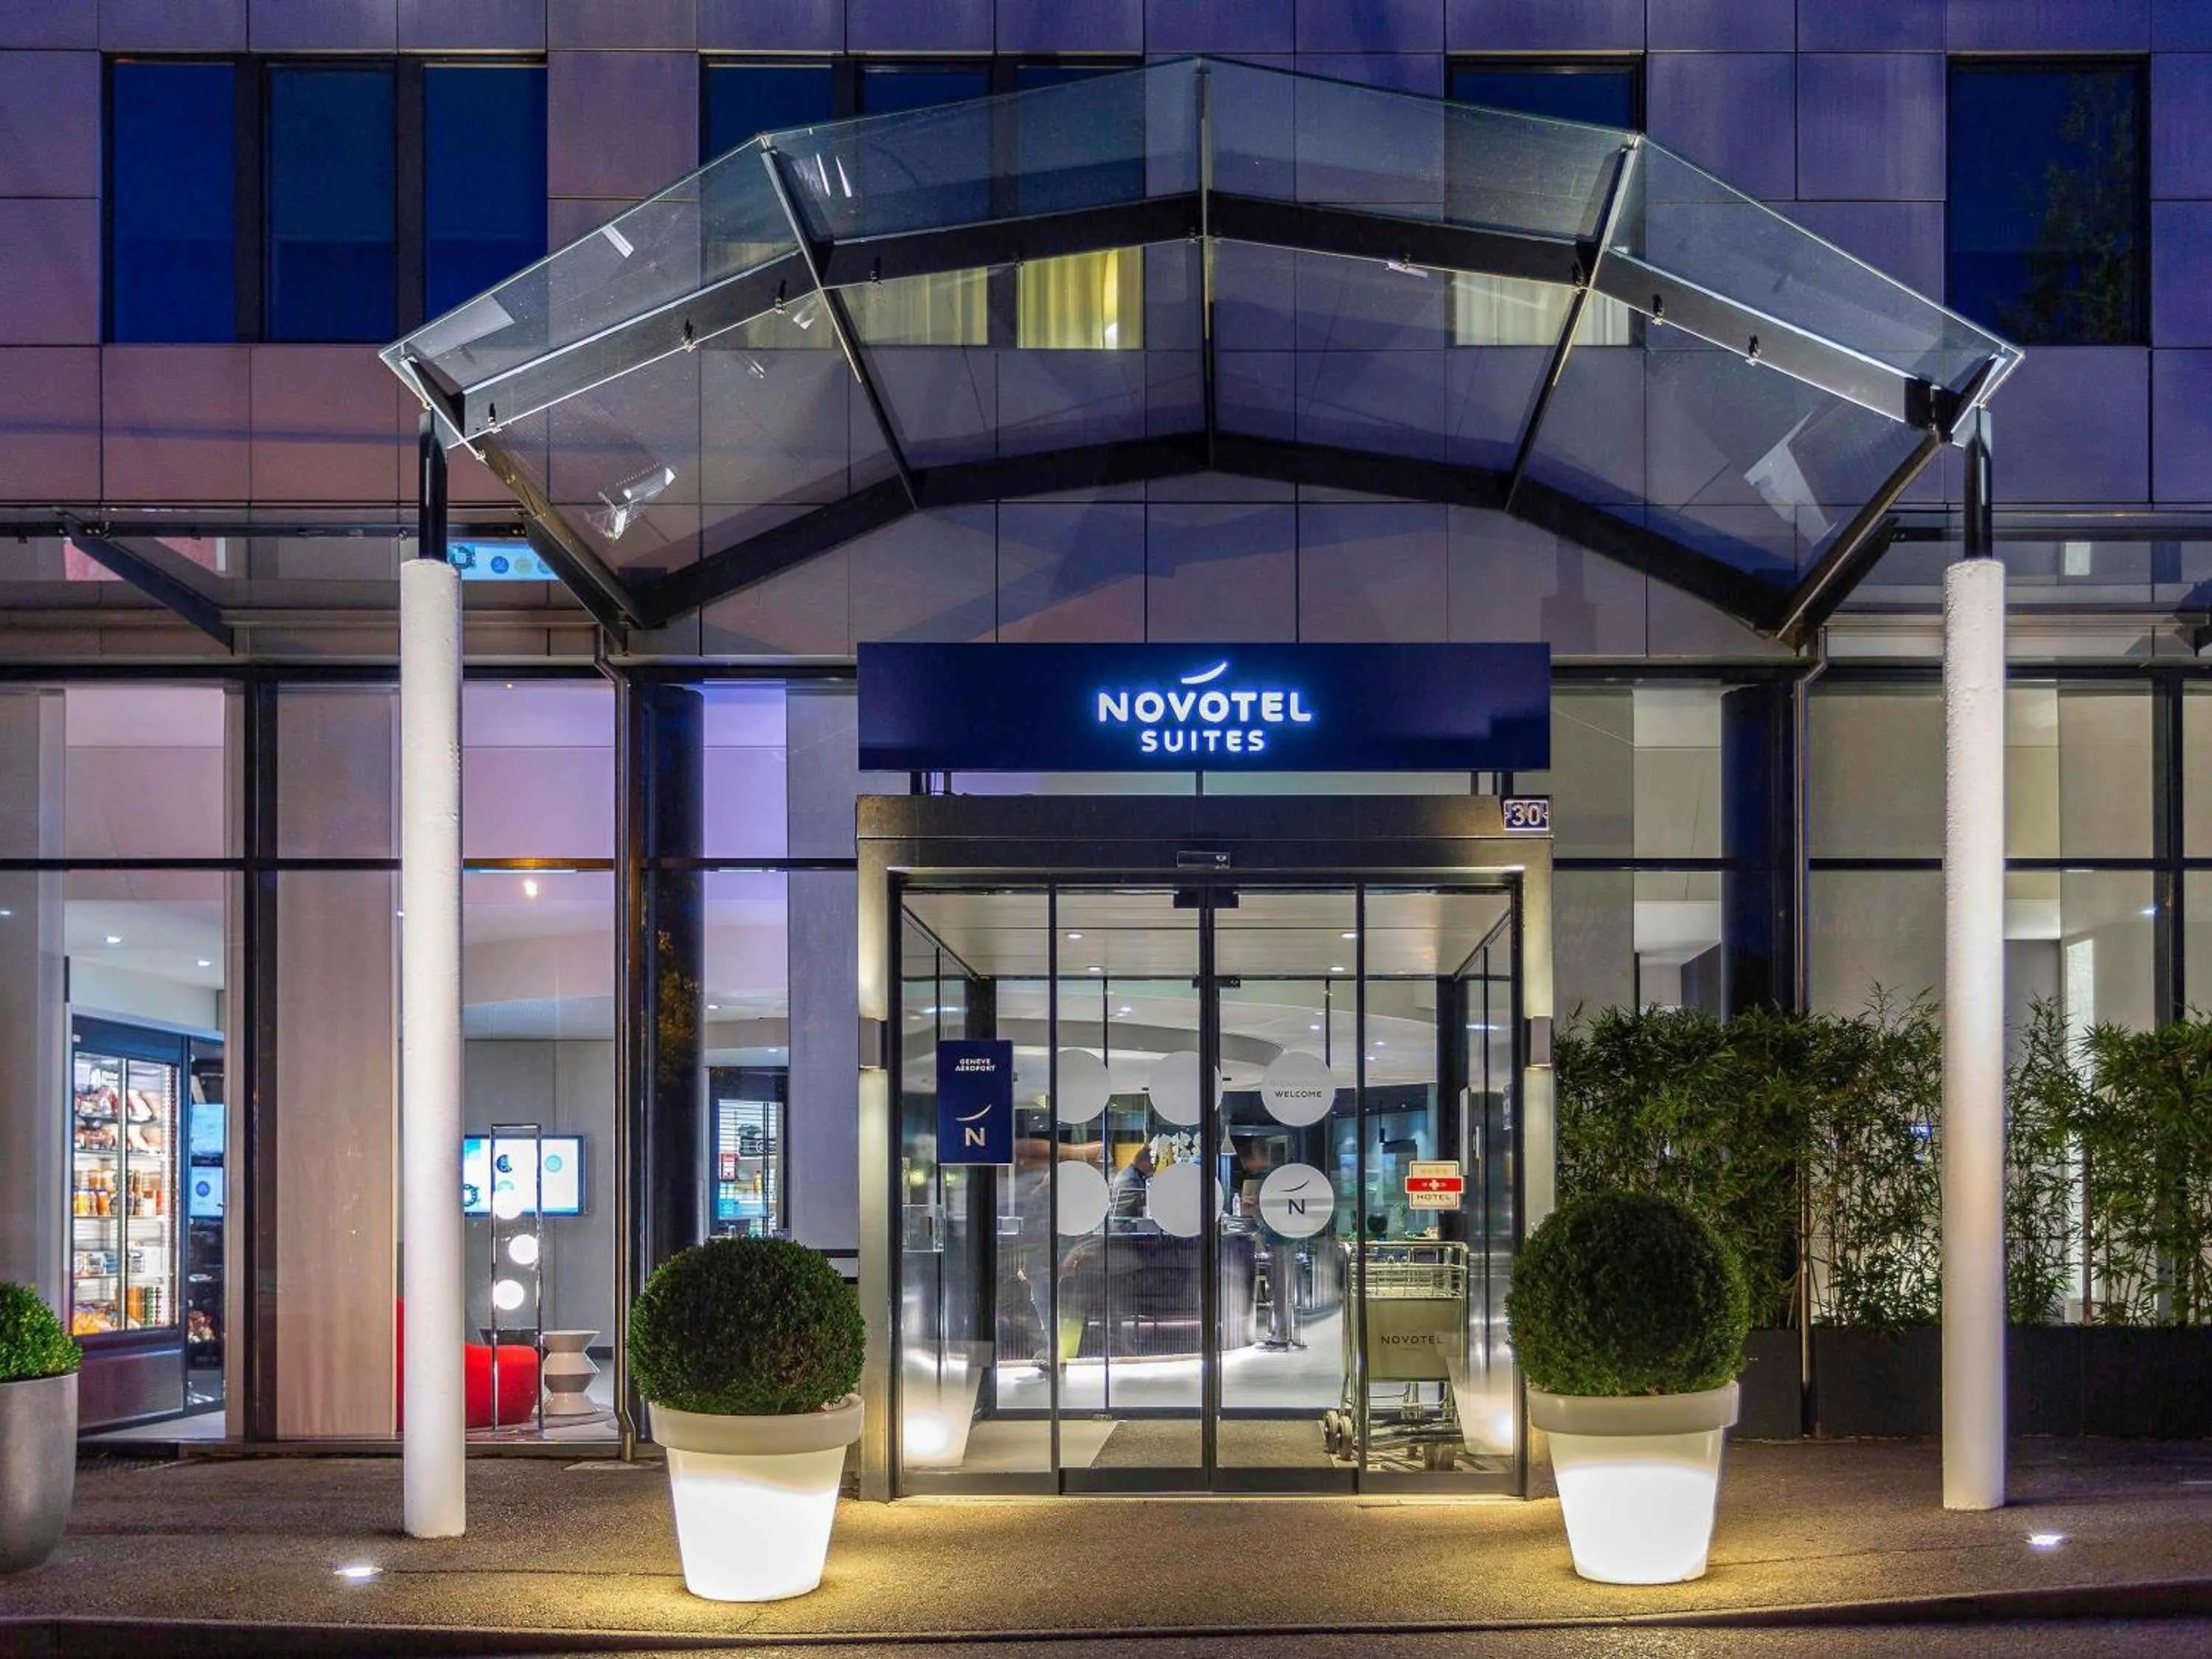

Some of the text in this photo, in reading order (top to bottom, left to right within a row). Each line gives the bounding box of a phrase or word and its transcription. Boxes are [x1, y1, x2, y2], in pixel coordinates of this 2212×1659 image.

[1098, 692, 1312, 723] NOVOTEL
[1141, 730, 1265, 752] SUITES
[1512, 804, 1541, 826] 30
[965, 1127, 985, 1147] N
[1288, 1198, 1305, 1214] N
[1381, 1335, 1446, 1344] NOVOTEL
